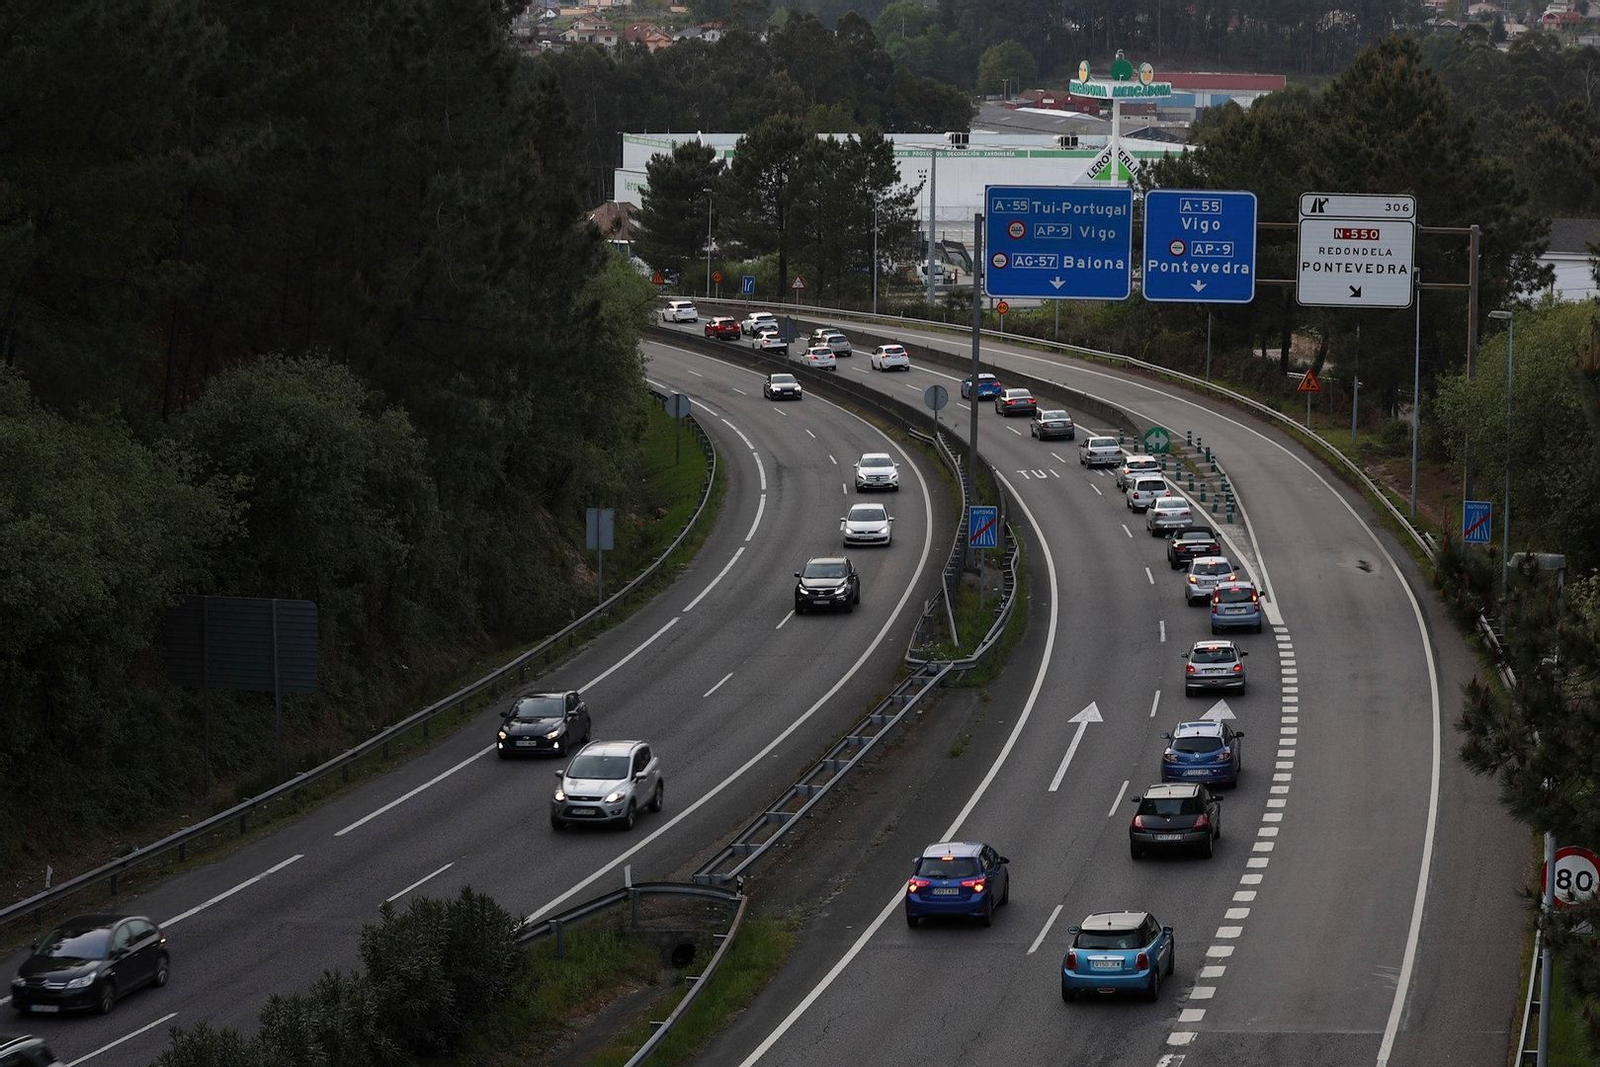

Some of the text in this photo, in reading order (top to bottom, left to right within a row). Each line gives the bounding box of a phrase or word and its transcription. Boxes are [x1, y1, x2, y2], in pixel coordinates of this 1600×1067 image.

[1112, 84, 1171, 97] MERCADONA
[994, 200, 1127, 218] A-55 Tui-Portugal
[1183, 200, 1220, 212] A-55
[1385, 203, 1409, 212] 306
[1181, 216, 1221, 233] Vigo
[1036, 225, 1117, 242] AP-9 Vigo
[1334, 229, 1379, 240] N-550
[1194, 243, 1232, 255] AP-9
[1318, 246, 1393, 257] REDONDELA
[1014, 256, 1125, 270] AG-57 Baiona
[1148, 259, 1250, 275] Pontevedra
[1302, 261, 1408, 275] PONTEVEDRA
[1016, 469, 1060, 480] TUI
[1556, 868, 1593, 892] 80
